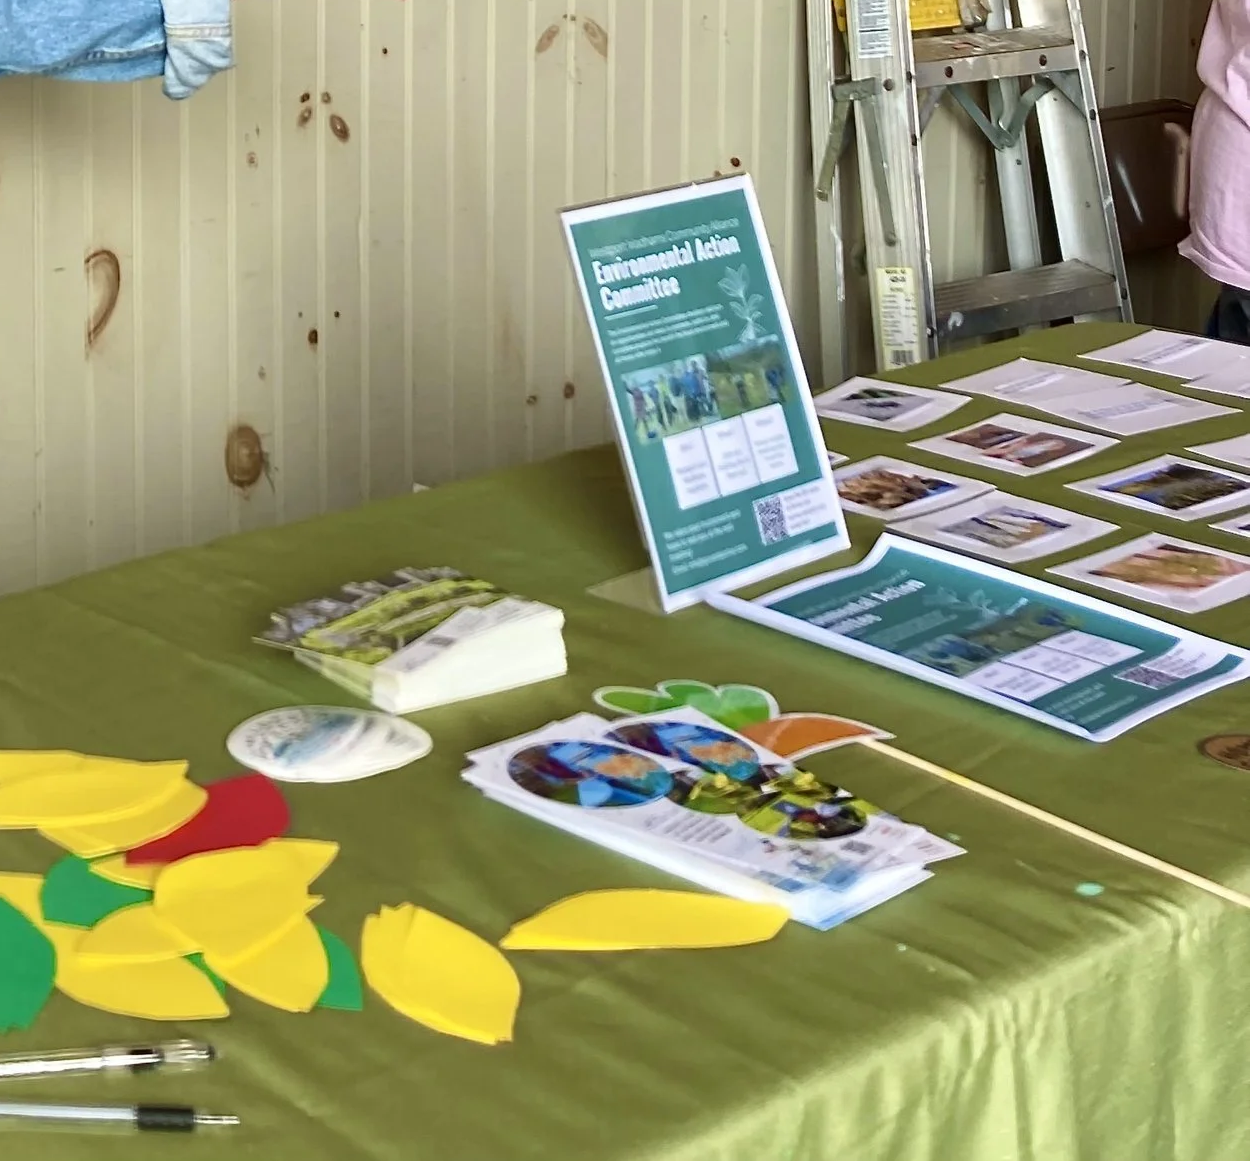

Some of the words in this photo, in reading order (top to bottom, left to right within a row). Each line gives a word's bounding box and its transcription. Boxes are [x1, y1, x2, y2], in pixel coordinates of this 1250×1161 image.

[591, 240, 696, 285] Environmental
[694, 234, 742, 262] Action
[599, 276, 682, 311] Committee
